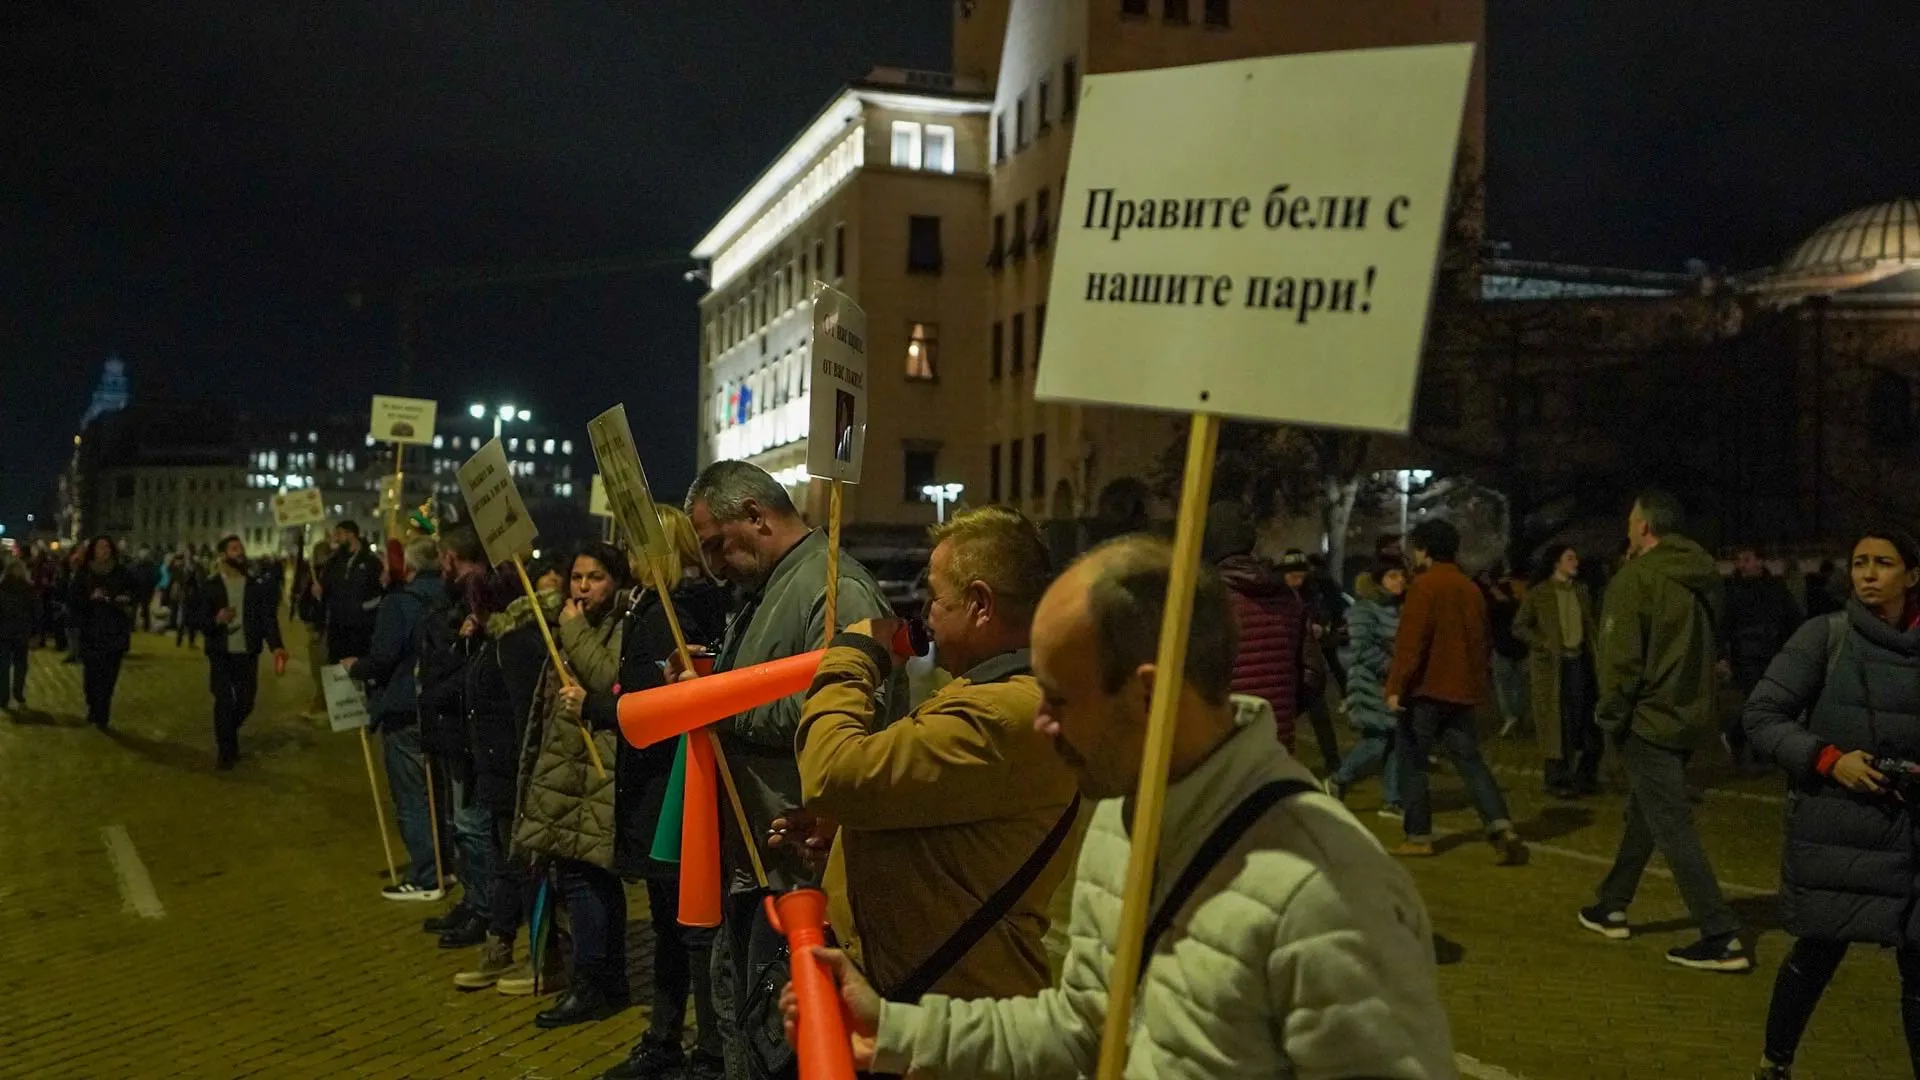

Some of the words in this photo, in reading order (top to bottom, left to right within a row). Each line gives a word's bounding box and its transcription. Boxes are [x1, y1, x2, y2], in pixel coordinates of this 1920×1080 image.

[1083, 187, 1250, 241] Правите
[1264, 183, 1371, 230] бели
[1385, 194, 1411, 230] с
[1084, 272, 1234, 308] нашите
[1243, 264, 1377, 325] пари!
